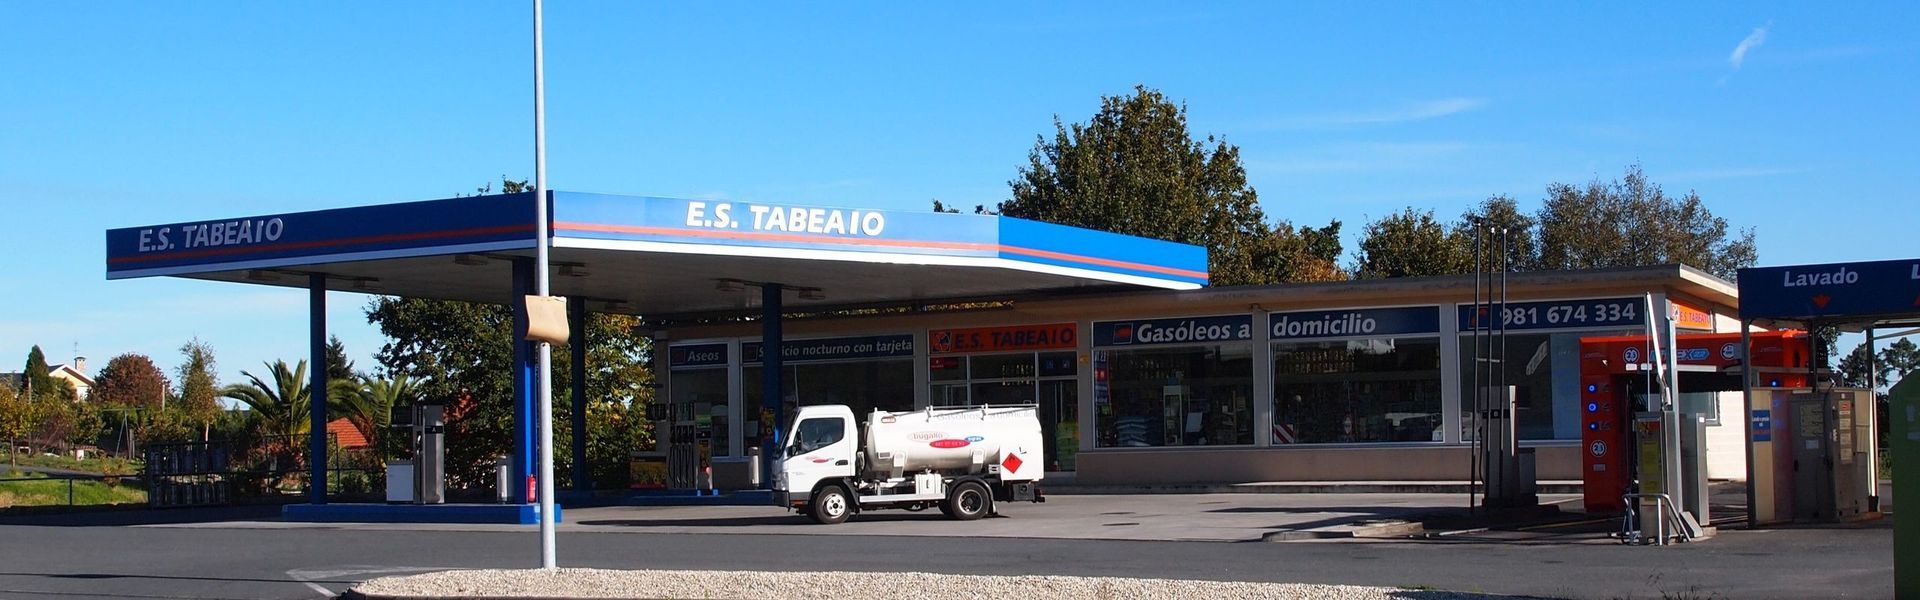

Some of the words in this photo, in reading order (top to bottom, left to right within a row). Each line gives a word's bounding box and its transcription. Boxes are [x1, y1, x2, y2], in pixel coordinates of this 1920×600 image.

[686, 201, 738, 229] E.S.
[750, 205, 885, 236] TABEAIO
[139, 227, 175, 252] E.S.
[182, 217, 284, 248] TABEAIO
[1784, 267, 1859, 287] Lavado
[1500, 307, 1537, 325] 981
[1546, 305, 1587, 324] 674
[1595, 303, 1635, 321] 334
[1137, 321, 1230, 342] Gasóleos
[1238, 323, 1250, 338] a
[1273, 313, 1377, 337] domicilio
[759, 342, 799, 357] Sicio
[802, 340, 850, 355] nocturno
[853, 342, 873, 353] con
[876, 339, 912, 354] tarjeta
[955, 333, 983, 349] E.S.
[992, 328, 1074, 346] TABEAIO
[687, 350, 719, 362] Aseos
